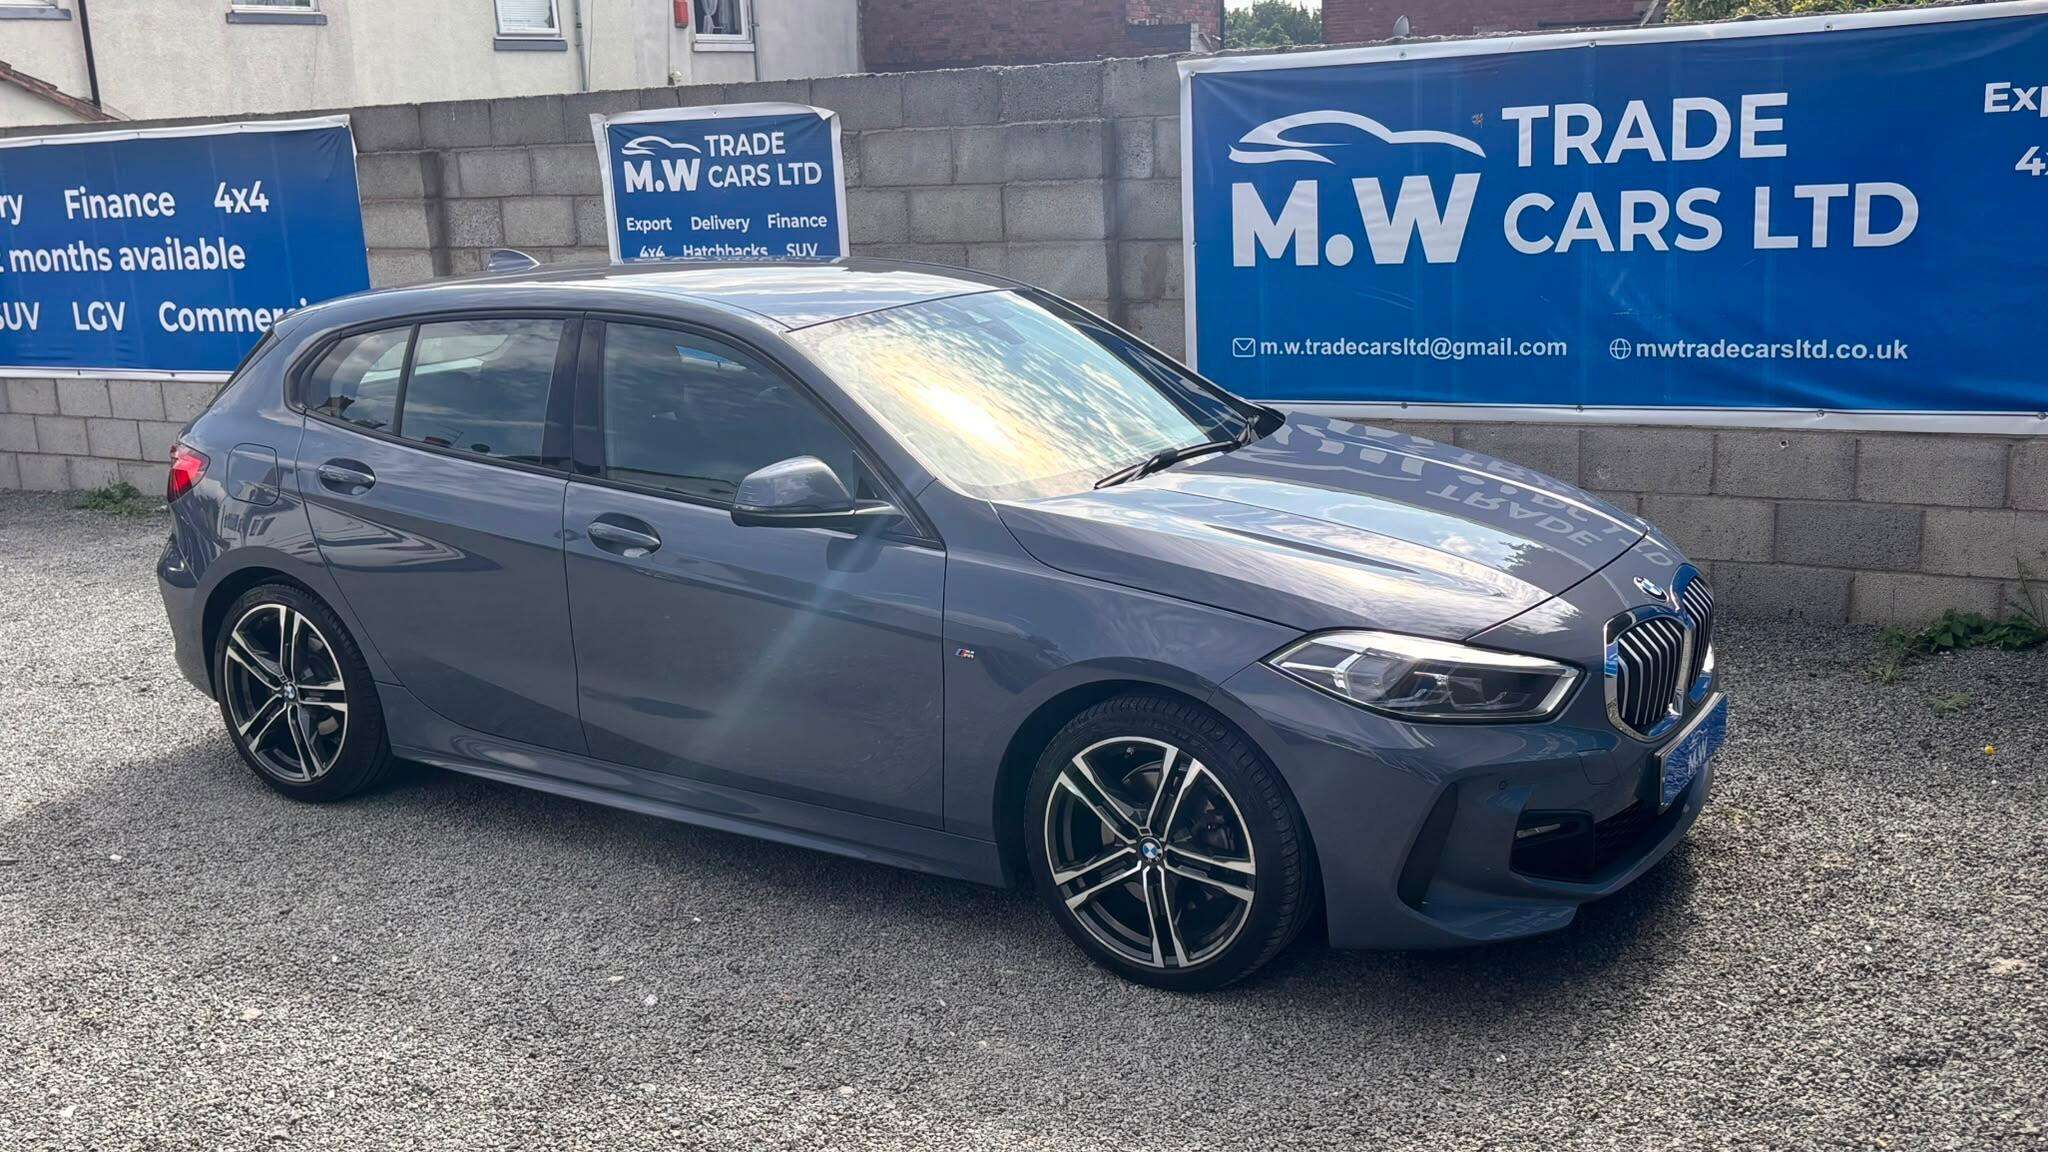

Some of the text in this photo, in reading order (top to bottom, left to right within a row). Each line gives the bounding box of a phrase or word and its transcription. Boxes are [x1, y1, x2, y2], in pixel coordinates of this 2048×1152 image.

[704, 131, 786, 157] TRADE
[1502, 93, 1788, 167] TRADE
[623, 158, 701, 193] M.W
[708, 162, 822, 188] CARS LTD
[2015, 146, 2048, 176] 4
[64, 186, 176, 220] Finance
[214, 180, 270, 214] 4x4
[626, 213, 828, 234] Export Delivery Finance
[1231, 173, 1481, 267] M.W
[1503, 182, 1919, 254] CARS LTD
[8, 240, 113, 273] months
[119, 236, 246, 271] available
[786, 242, 818, 257] SUV
[72, 301, 126, 331] LGV
[1260, 337, 1567, 361] m.w.tradecarsltd@gmail.com
[1636, 339, 1909, 360] mwtradecarsltd.co.uk
